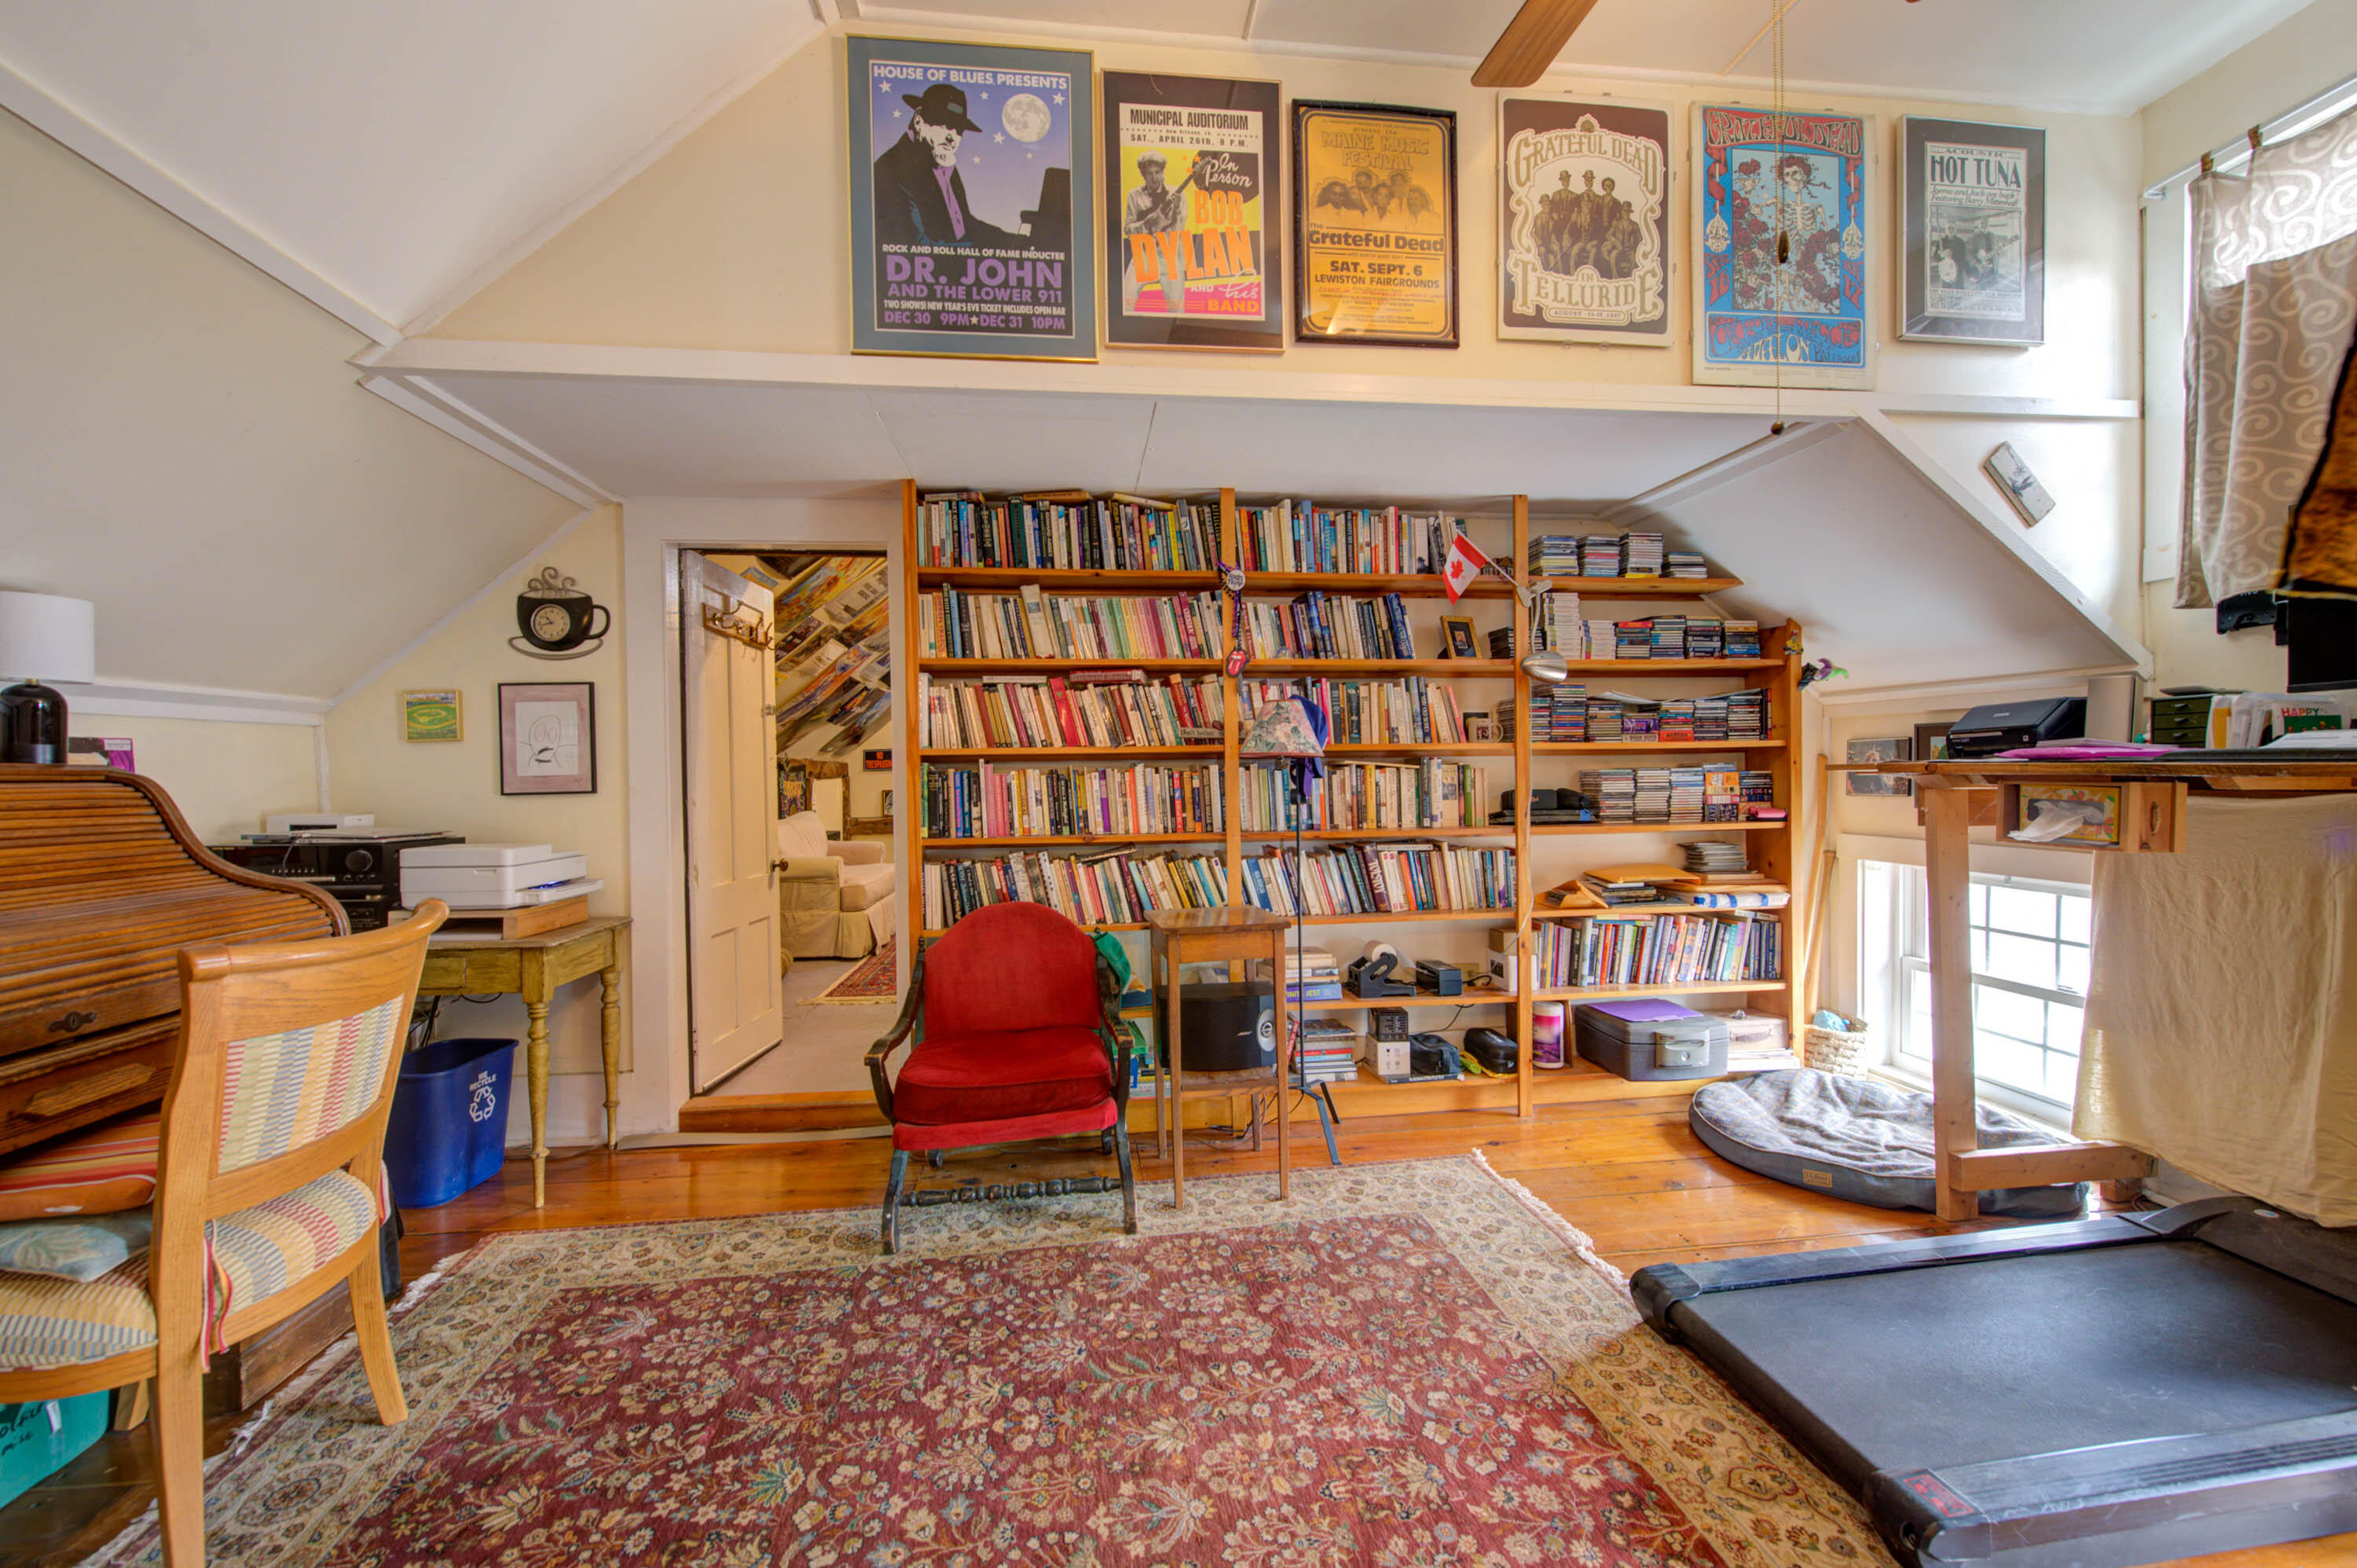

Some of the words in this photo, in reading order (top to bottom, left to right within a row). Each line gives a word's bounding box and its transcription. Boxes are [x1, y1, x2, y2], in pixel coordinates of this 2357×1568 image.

[874, 65, 923, 80] HOUSE
[927, 69, 947, 81] OF
[950, 71, 993, 85] BLUES
[998, 74, 1067, 90] PRESENTS
[1130, 108, 1183, 126] MUNICIPAL
[1187, 112, 1248, 130] AUDITORIUM
[1321, 131, 1374, 150] MAINE
[1381, 136, 1429, 154] MUSIC
[1708, 112, 1808, 145] GRATEFUL
[1810, 119, 1862, 155] DEAD
[1219, 152, 1239, 171] In
[1343, 151, 1413, 171] FESTIVAL
[1516, 132, 1607, 188] GRATEFUL
[1611, 137, 1657, 196] DEAD
[1201, 158, 1252, 188] Person
[1930, 156, 1968, 183] HOT
[1973, 158, 2021, 188] TUNA
[1194, 189, 1244, 225] BOB
[1310, 231, 1390, 248] Grateful
[1395, 236, 1444, 251] Dead
[911, 245, 931, 254] AND
[933, 246, 955, 255] ROLL
[957, 247, 981, 256] HALL
[983, 248, 994, 257] OF
[996, 249, 1020, 258] FAME
[1022, 250, 1065, 261] INDUCTEE
[1130, 225, 1255, 283] DYLAN
[886, 255, 948, 284] DR.
[960, 258, 1061, 288] JOHN
[1330, 261, 1364, 273] SAT.
[1368, 263, 1410, 275] SEPT.
[1413, 266, 1422, 276] 6
[1190, 283, 1214, 293] AND
[1315, 274, 1365, 284] LEWISTON
[1370, 277, 1439, 288] FAIRGROUNDS
[1514, 258, 1658, 315] TELLURIDE
[887, 284, 928, 298] AND
[933, 285, 966, 299] THE
[972, 287, 1032, 302] LOWER
[1039, 290, 1061, 303] 911
[884, 300, 899, 309] TWO
[900, 301, 926, 310] SHOWS!
[927, 302, 942, 310] NEW
[944, 302, 966, 312] YEAR'S
[967, 303, 979, 312] EVE
[981, 304, 1002, 313] TICKET
[1003, 305, 1032, 314] INCLUDES
[1034, 306, 1051, 314] OPEN
[1053, 306, 1065, 315] BAR
[1208, 299, 1259, 313] BAND
[885, 311, 910, 324] DEC
[914, 313, 931, 324] 30
[940, 313, 970, 326] 9PM
[981, 315, 1005, 327] DEC
[1009, 317, 1022, 328] 31
[1032, 317, 1065, 329] 10PM
[2281, 707, 2320, 717] HAPPY
[866, 760, 893, 769] TRESPASSIN
[876, 751, 884, 760] NO
[470, 1075, 497, 1091] RECYCLE
[478, 1071, 488, 1081] WE
